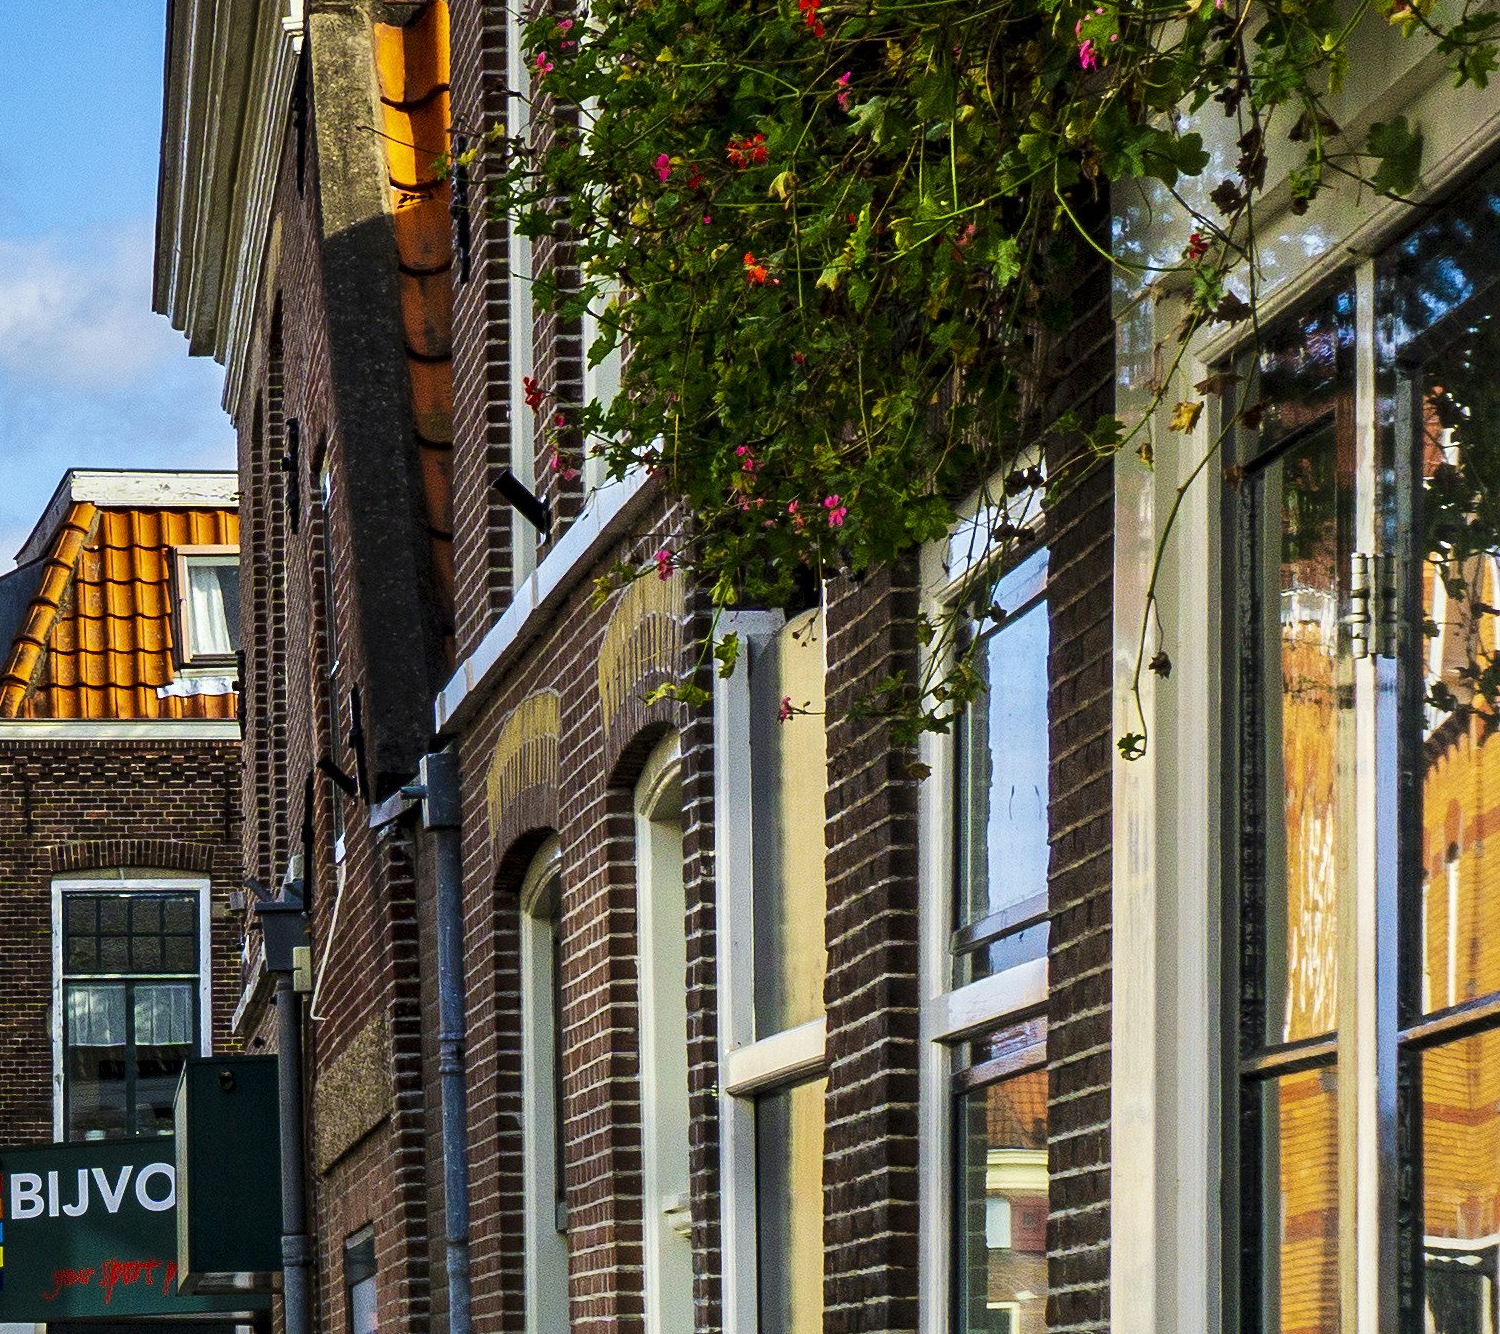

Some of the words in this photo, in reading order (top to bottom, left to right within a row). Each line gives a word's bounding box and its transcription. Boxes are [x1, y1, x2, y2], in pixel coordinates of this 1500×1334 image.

[10, 1162, 176, 1220] BIJVO
[42, 1267, 96, 1301] your
[98, 1256, 164, 1305] sport
